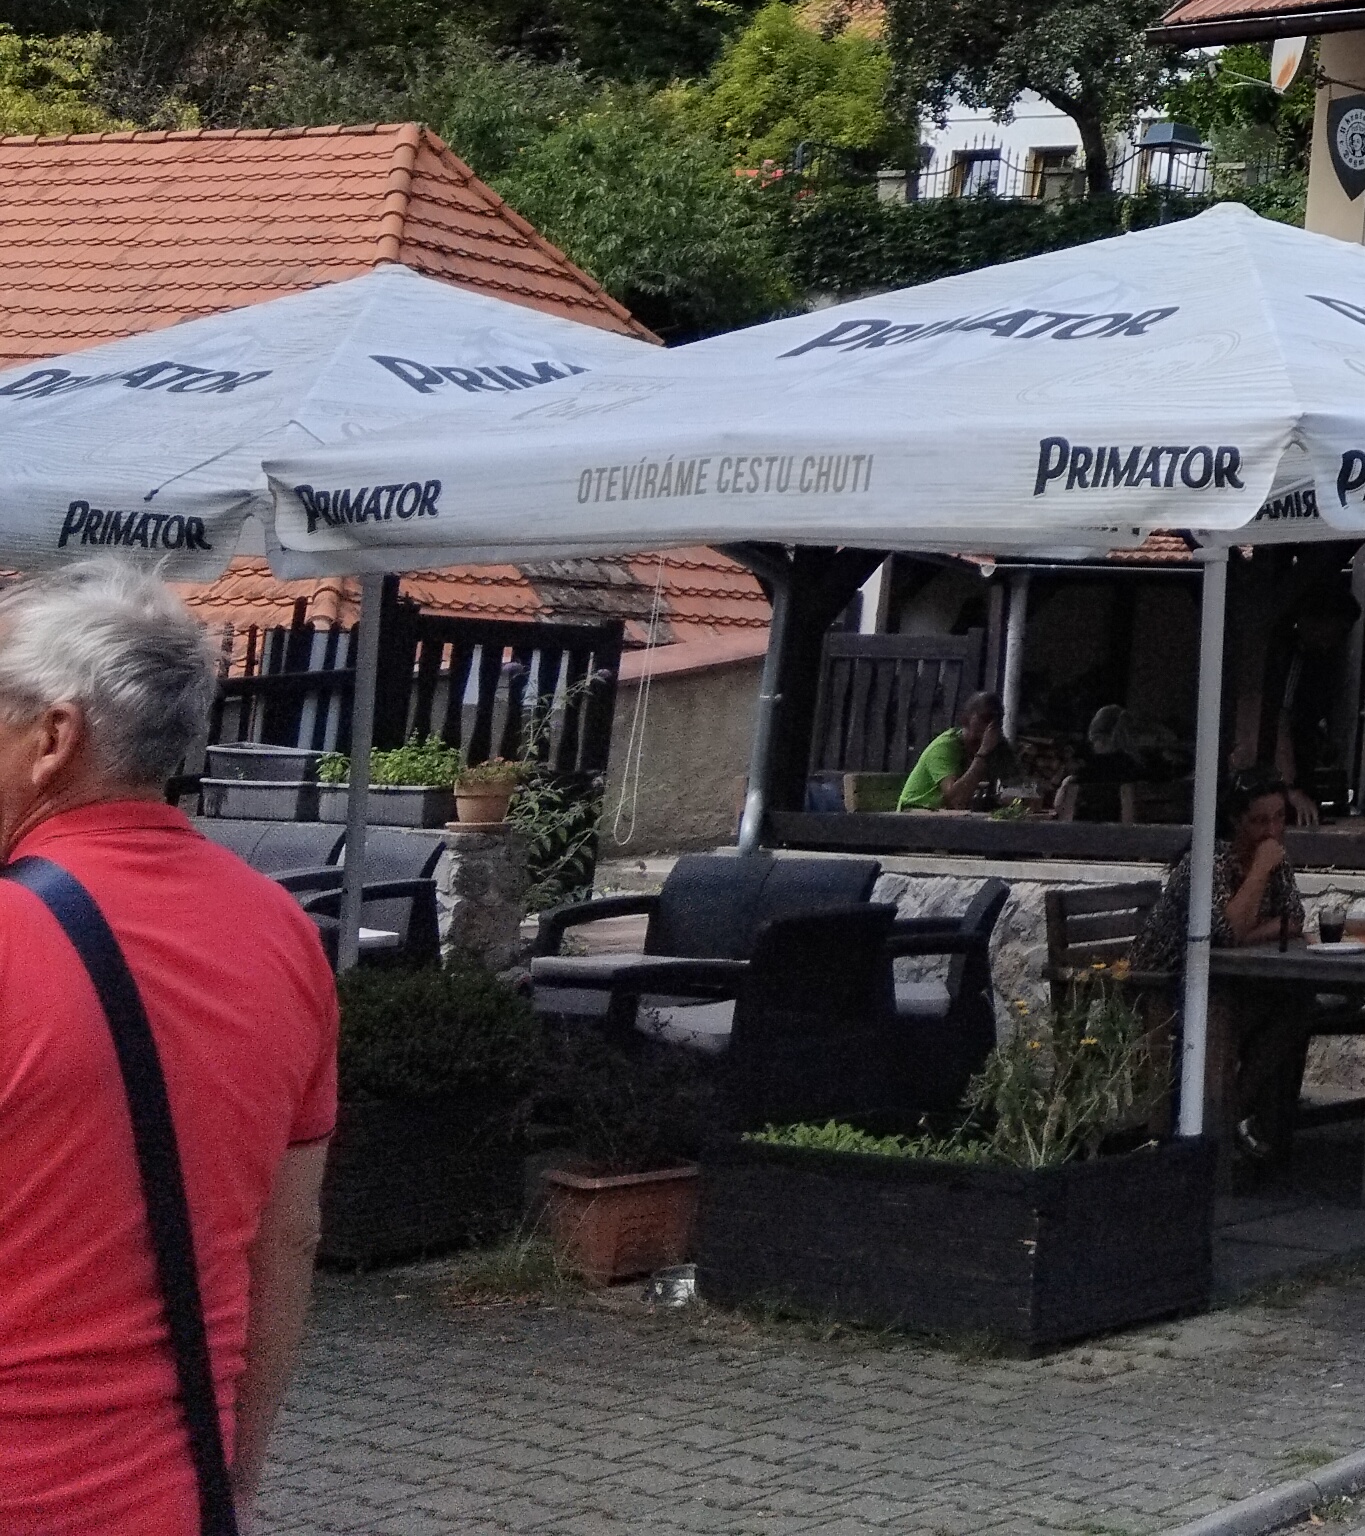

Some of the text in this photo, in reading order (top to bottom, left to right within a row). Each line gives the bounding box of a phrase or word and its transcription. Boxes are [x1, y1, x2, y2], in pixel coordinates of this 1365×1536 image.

[577, 453, 875, 504] OTEVÍRÁME CESTU CHUTI
[1033, 435, 1246, 497] PRIMATOR
[58, 499, 212, 549] PRIMATOR
[294, 479, 442, 534] PRIMATOR
